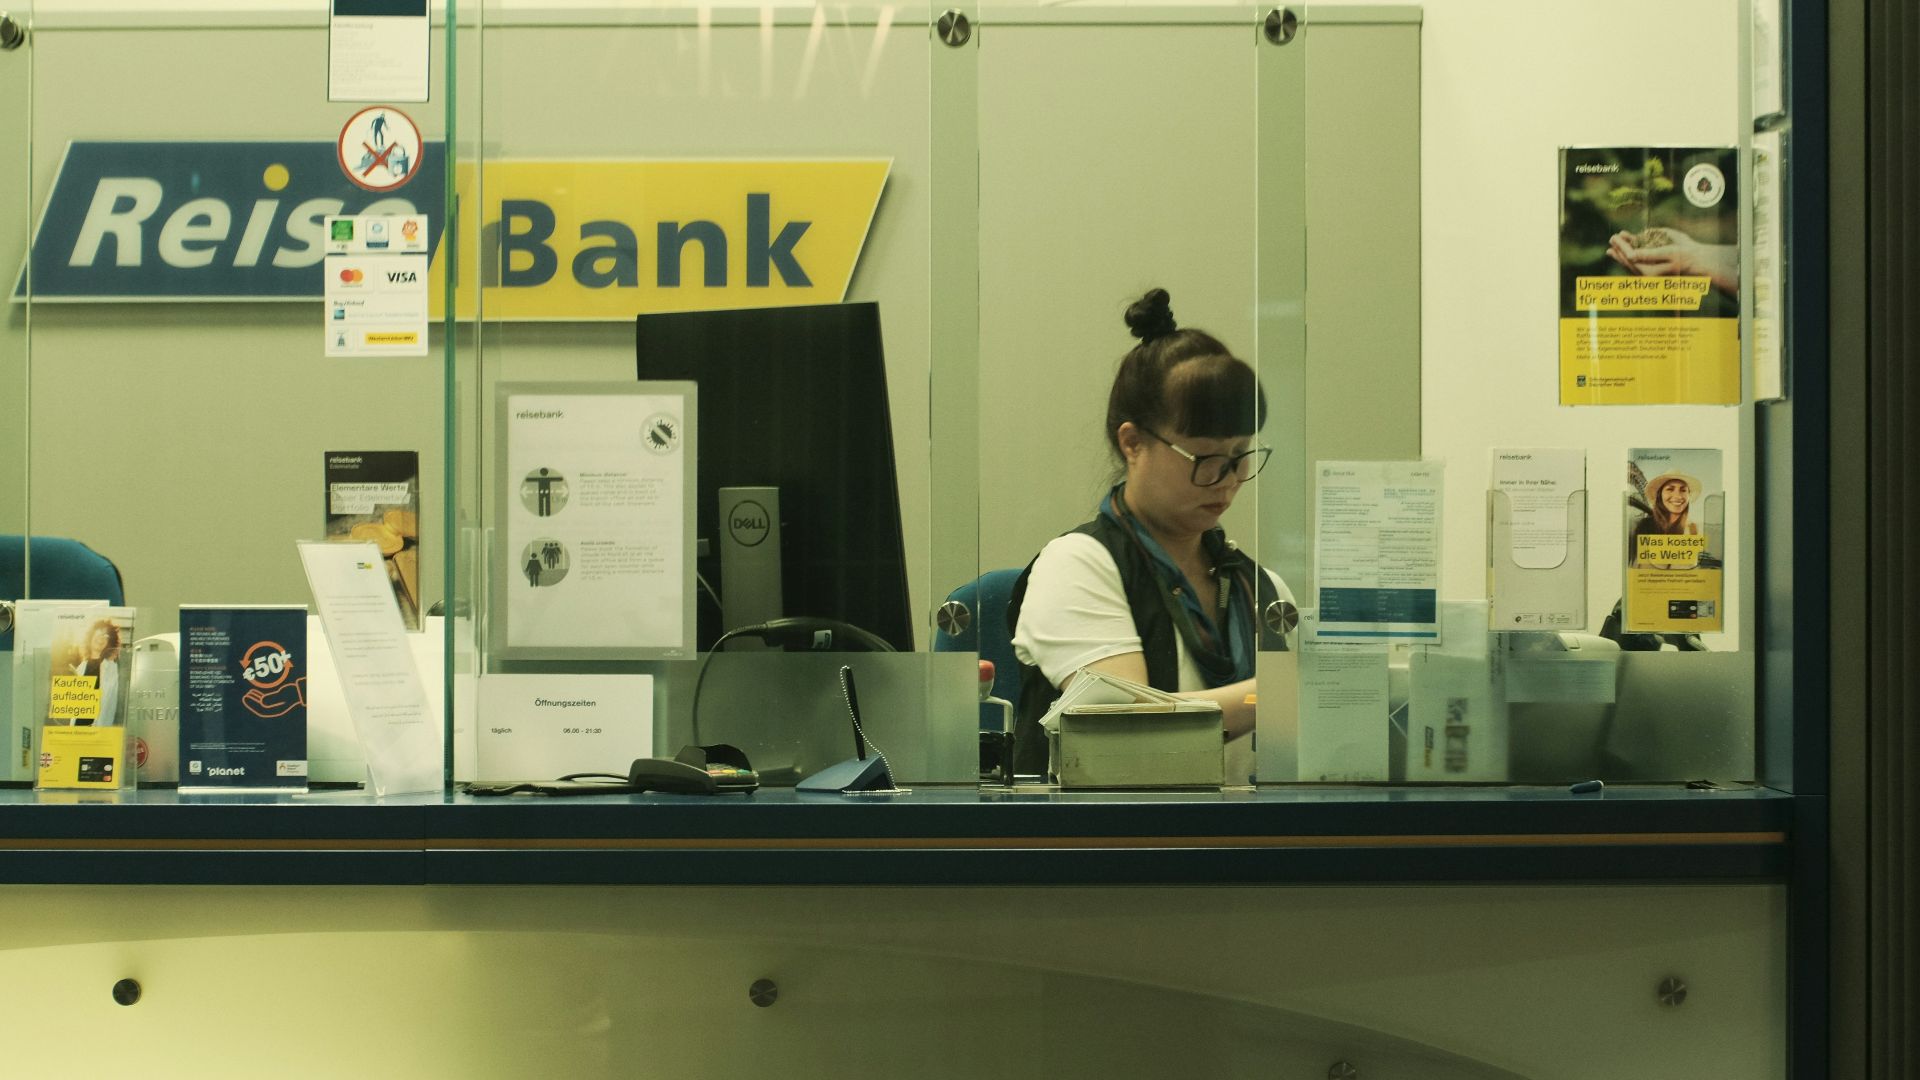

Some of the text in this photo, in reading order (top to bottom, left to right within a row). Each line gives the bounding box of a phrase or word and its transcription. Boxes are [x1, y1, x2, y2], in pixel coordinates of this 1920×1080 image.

[1575, 164, 1619, 174] reisebank
[68, 164, 814, 289] Reis Bank
[387, 272, 417, 283] VISA
[1579, 278, 1707, 292] Unser aktiver Beitrag
[1579, 294, 1697, 307] für ein gutes Klima.
[516, 409, 563, 420] reisebank
[332, 484, 406, 492] Elementare Werte
[733, 518, 766, 530] DELL
[1640, 536, 1705, 547] Was kostet
[1640, 550, 1693, 560] die Welt?
[242, 650, 292, 681] €50+
[54, 678, 92, 689] Kaufen,
[52, 691, 99, 702] aufladen,
[534, 698, 597, 708] Öffnungszeiten
[51, 704, 96, 716] loslegen!
[491, 727, 513, 735] täglich
[207, 767, 245, 776] planet
